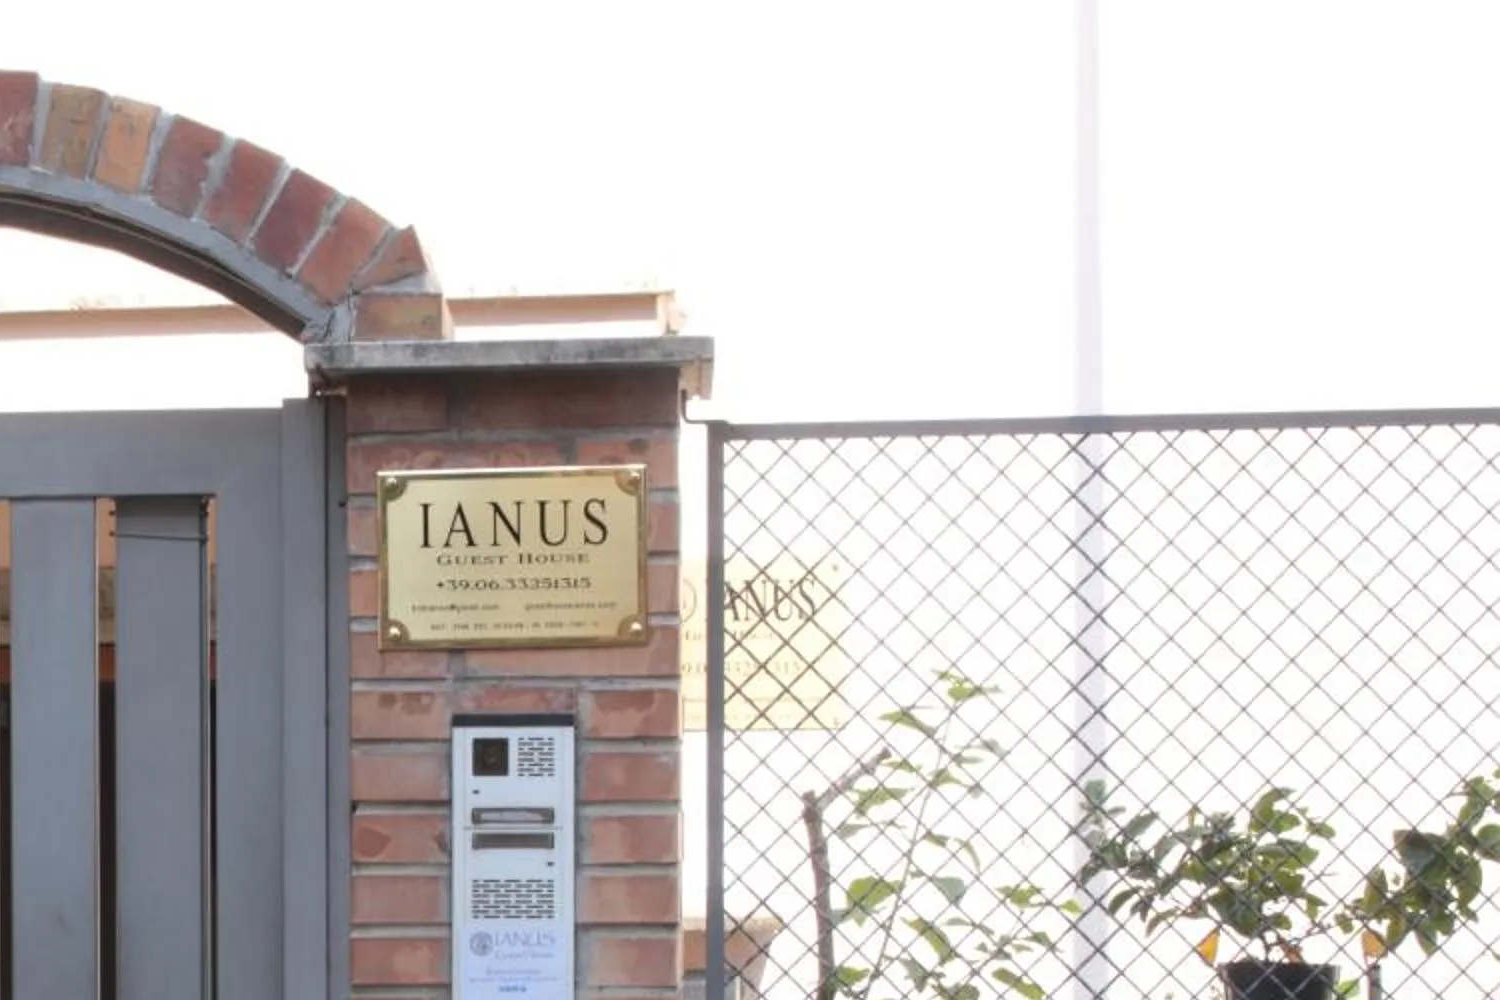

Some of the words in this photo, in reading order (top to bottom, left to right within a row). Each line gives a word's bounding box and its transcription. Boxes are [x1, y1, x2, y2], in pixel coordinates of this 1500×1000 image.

[420, 498, 608, 549] IANUS
[436, 554, 508, 566] GUEST
[519, 552, 590, 565] HOUSE
